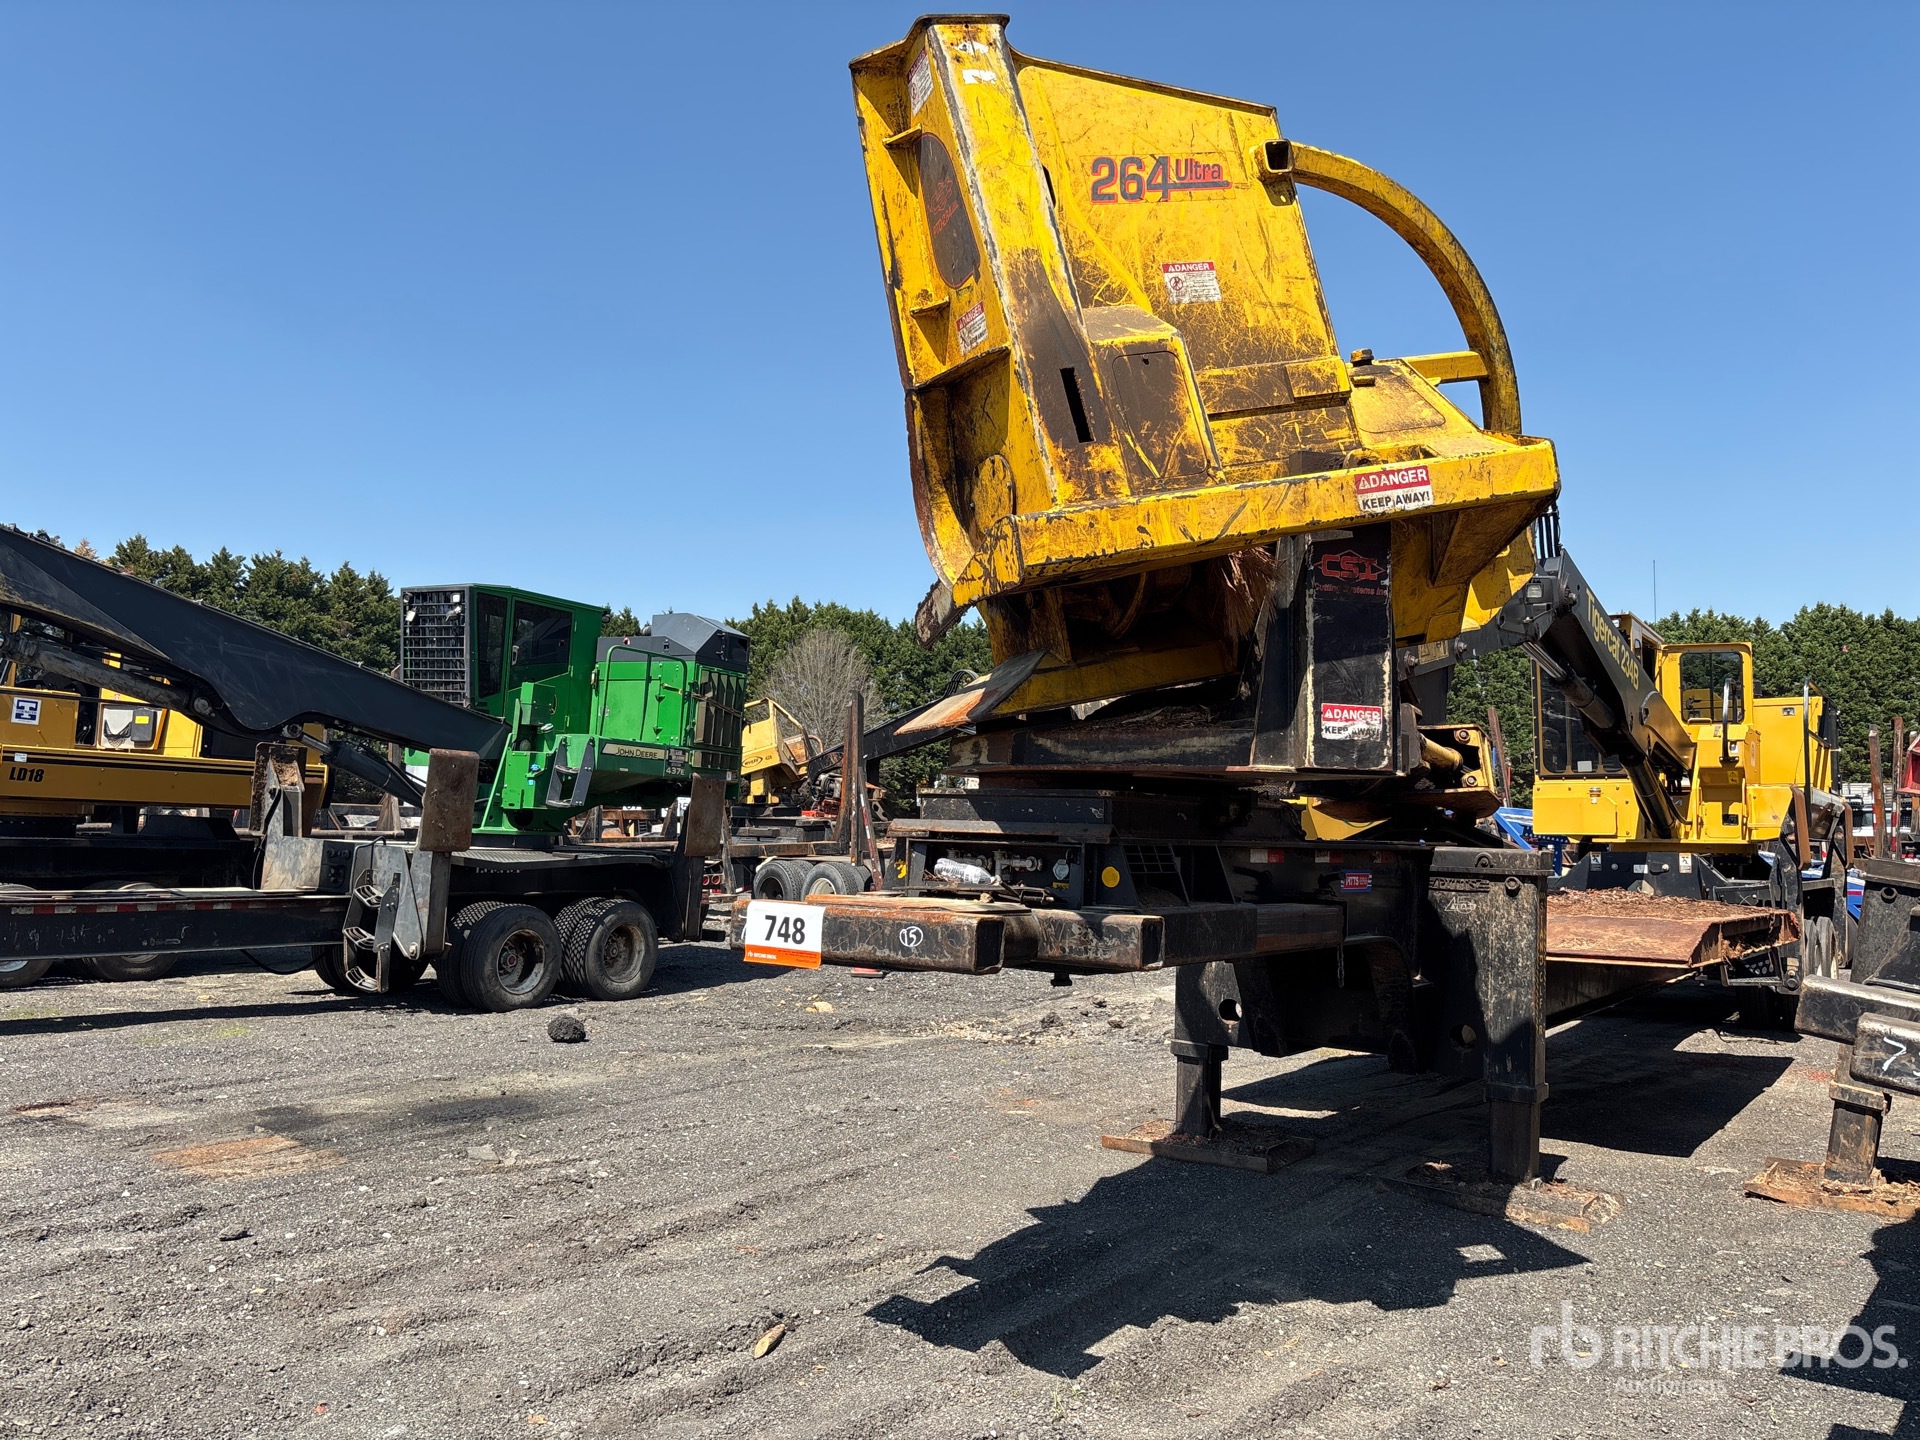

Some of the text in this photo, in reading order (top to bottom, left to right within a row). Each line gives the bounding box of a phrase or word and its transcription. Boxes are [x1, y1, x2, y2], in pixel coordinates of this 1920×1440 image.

[1091, 155, 1223, 203] 264 Ultra
[1174, 263, 1210, 271] DANGER
[1369, 468, 1428, 487] DANGER
[1362, 491, 1430, 509] KEEP AWAY!
[1321, 554, 1378, 580] CSI
[1585, 588, 1639, 690] Tigercat 234B
[1334, 708, 1381, 721] DANGER
[1324, 726, 1349, 734] KEEP
[615, 747, 635, 757] JOHN
[635, 749, 658, 758] DEERE
[9, 766, 45, 783] LD18
[665, 766, 686, 776] 437E
[764, 914, 806, 945] 748
